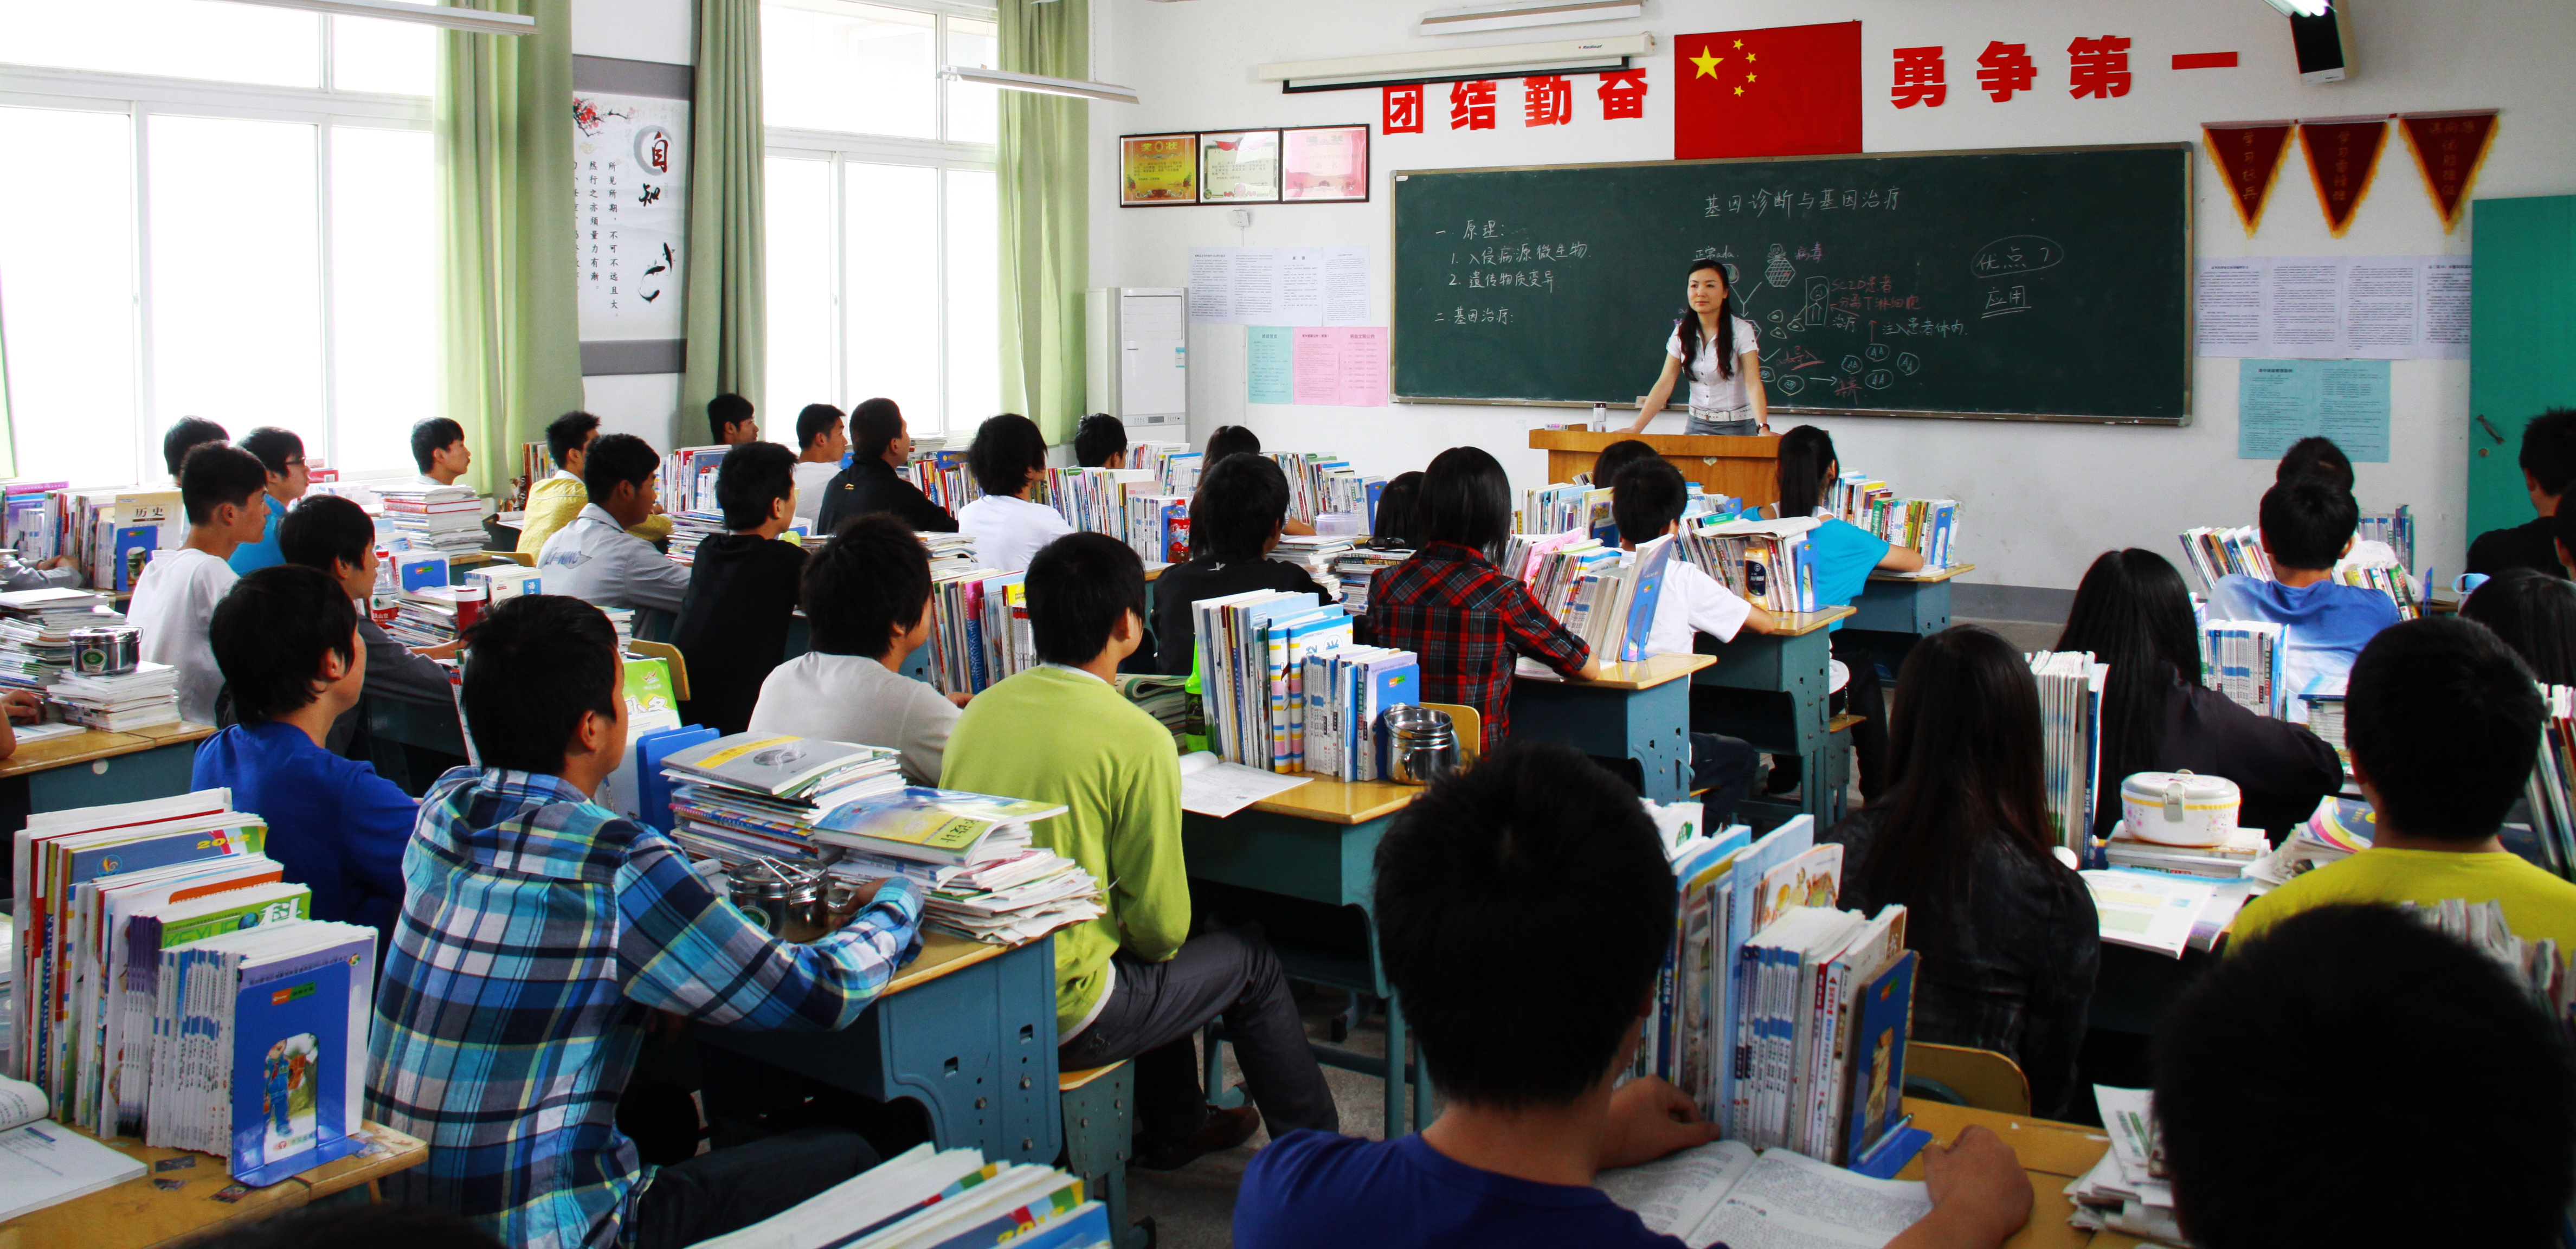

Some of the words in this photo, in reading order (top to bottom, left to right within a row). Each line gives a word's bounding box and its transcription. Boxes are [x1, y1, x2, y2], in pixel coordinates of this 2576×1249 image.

[1891, 35, 2238, 109] 勇争第一
[1383, 68, 1647, 135] 团结勤奋
[1704, 186, 1902, 218] 基因诊断与基因治疗
[1794, 242, 1824, 263] 病毒
[1985, 286, 2026, 310] 应用
[196, 834, 250, 850] 2012
